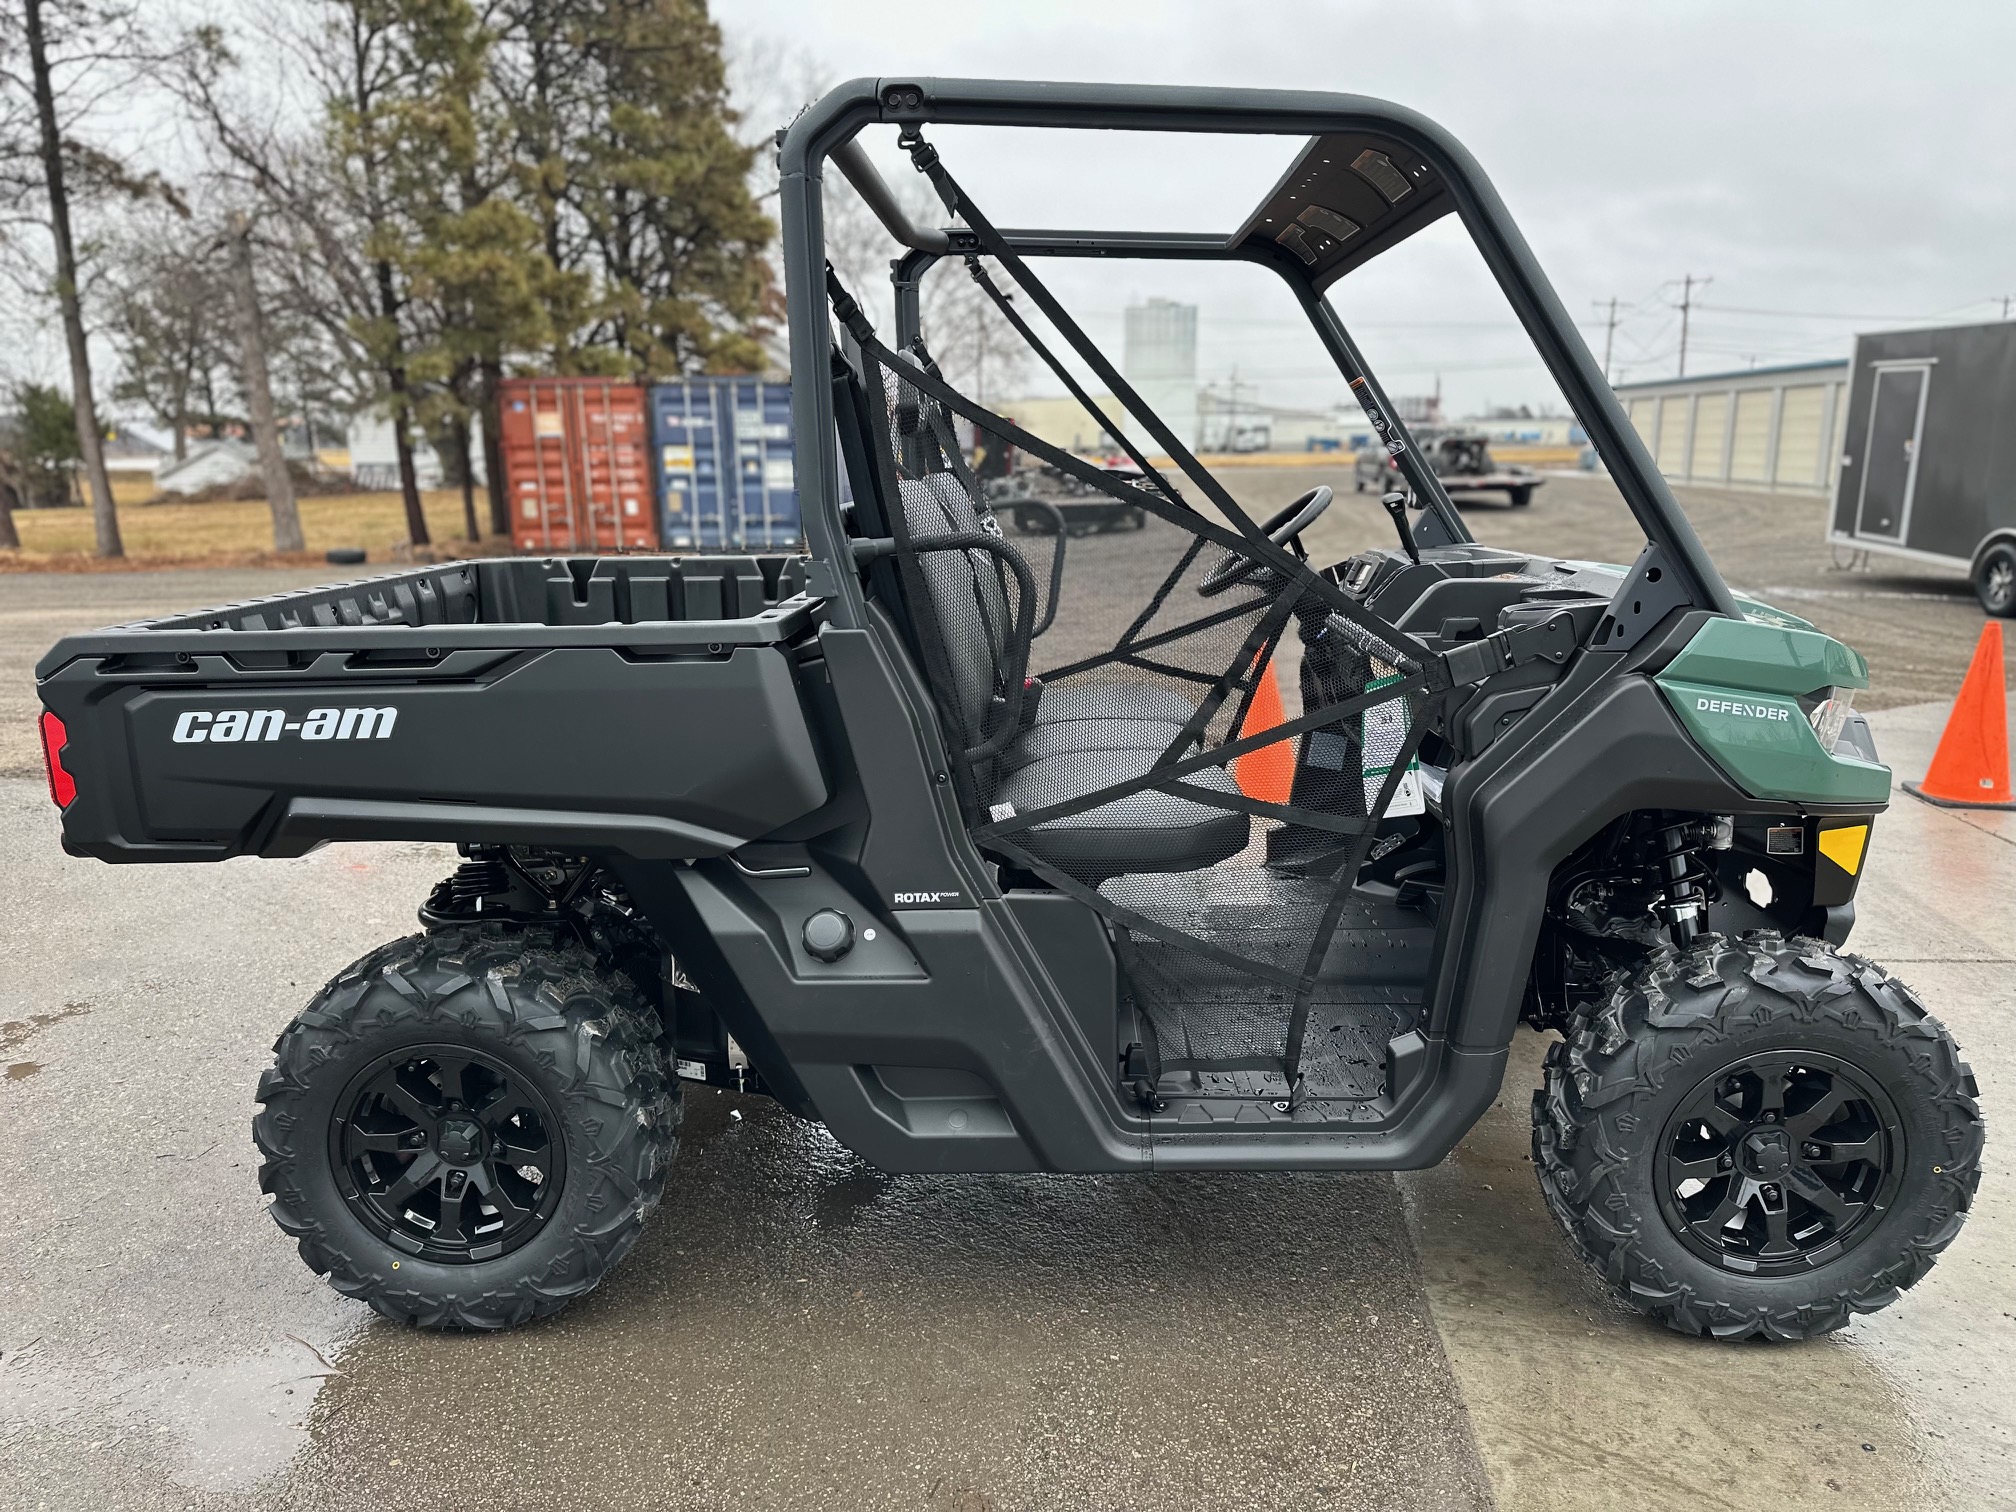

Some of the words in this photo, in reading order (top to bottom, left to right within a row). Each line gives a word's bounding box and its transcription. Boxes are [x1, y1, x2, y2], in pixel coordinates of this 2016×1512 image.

[1697, 698, 1789, 721] DEFENDER
[172, 706, 398, 743] can-am
[894, 892, 940, 903] ROTAX
